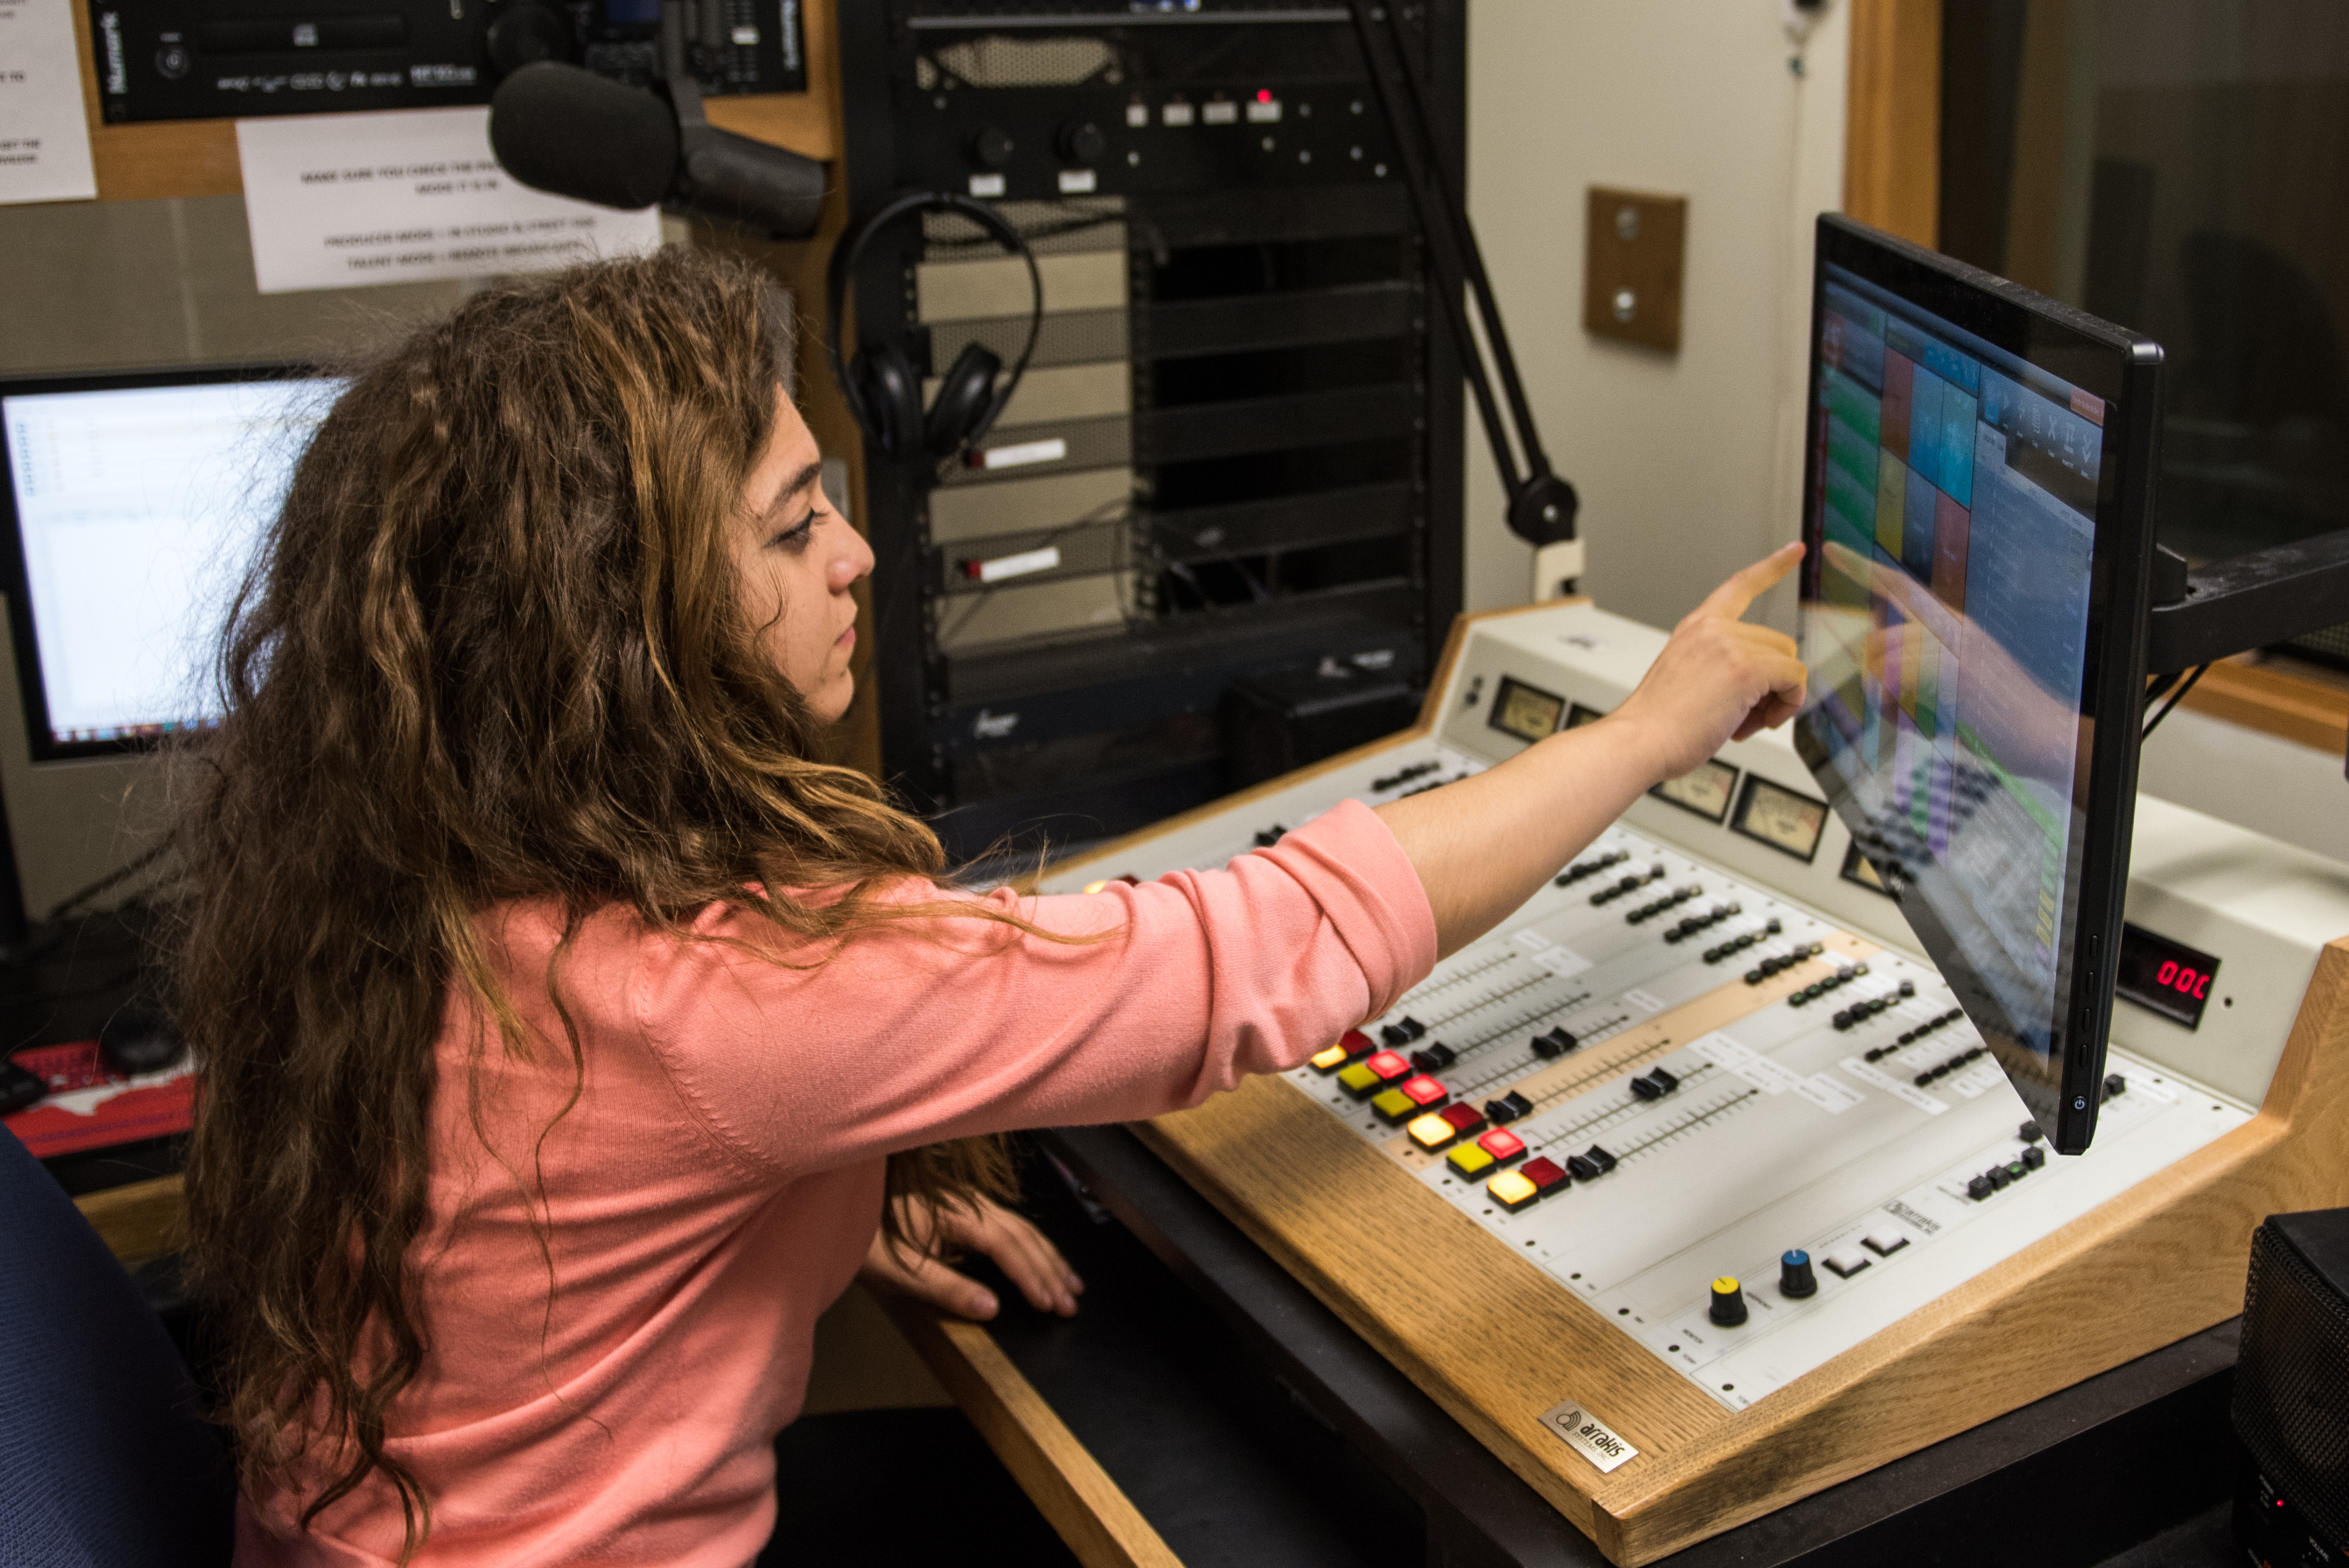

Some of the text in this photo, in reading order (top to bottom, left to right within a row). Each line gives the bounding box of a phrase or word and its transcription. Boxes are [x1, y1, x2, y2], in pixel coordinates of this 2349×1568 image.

[379, 166, 403, 179] YOU
[415, 181, 452, 195] MODE
[396, 229, 434, 243] MODE
[397, 251, 435, 265] MODE
[1580, 1423, 1626, 1458] arrakis
